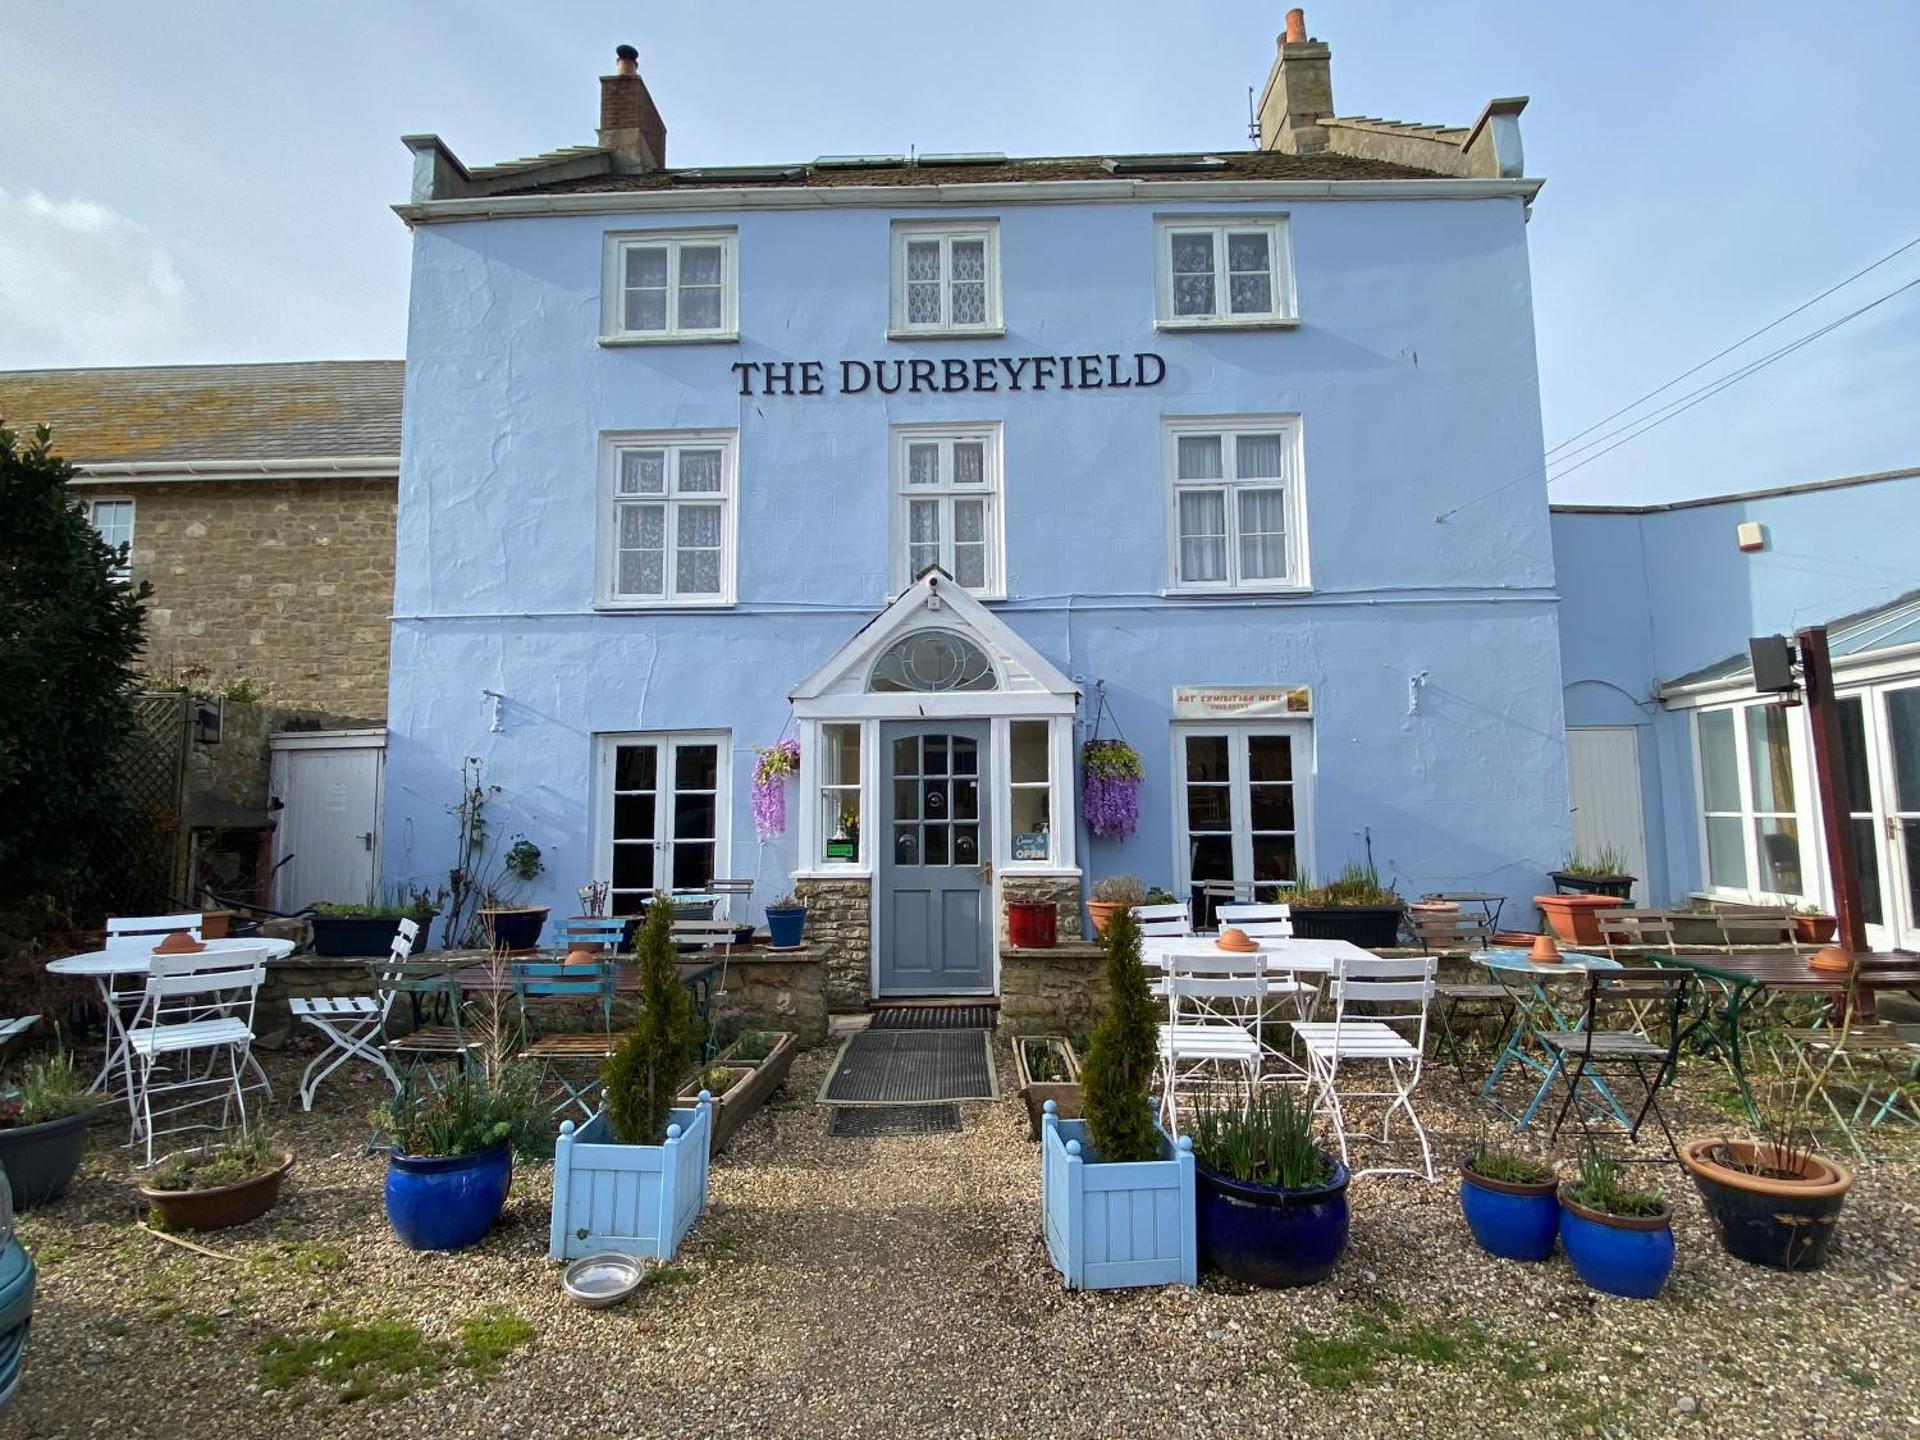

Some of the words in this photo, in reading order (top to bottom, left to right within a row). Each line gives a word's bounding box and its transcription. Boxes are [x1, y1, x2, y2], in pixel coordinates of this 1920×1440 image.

[731, 361, 824, 395] THE
[840, 353, 1167, 394] DURBEYFIELD
[1177, 695, 1196, 703] ART
[1016, 849, 1045, 859] OPEN
